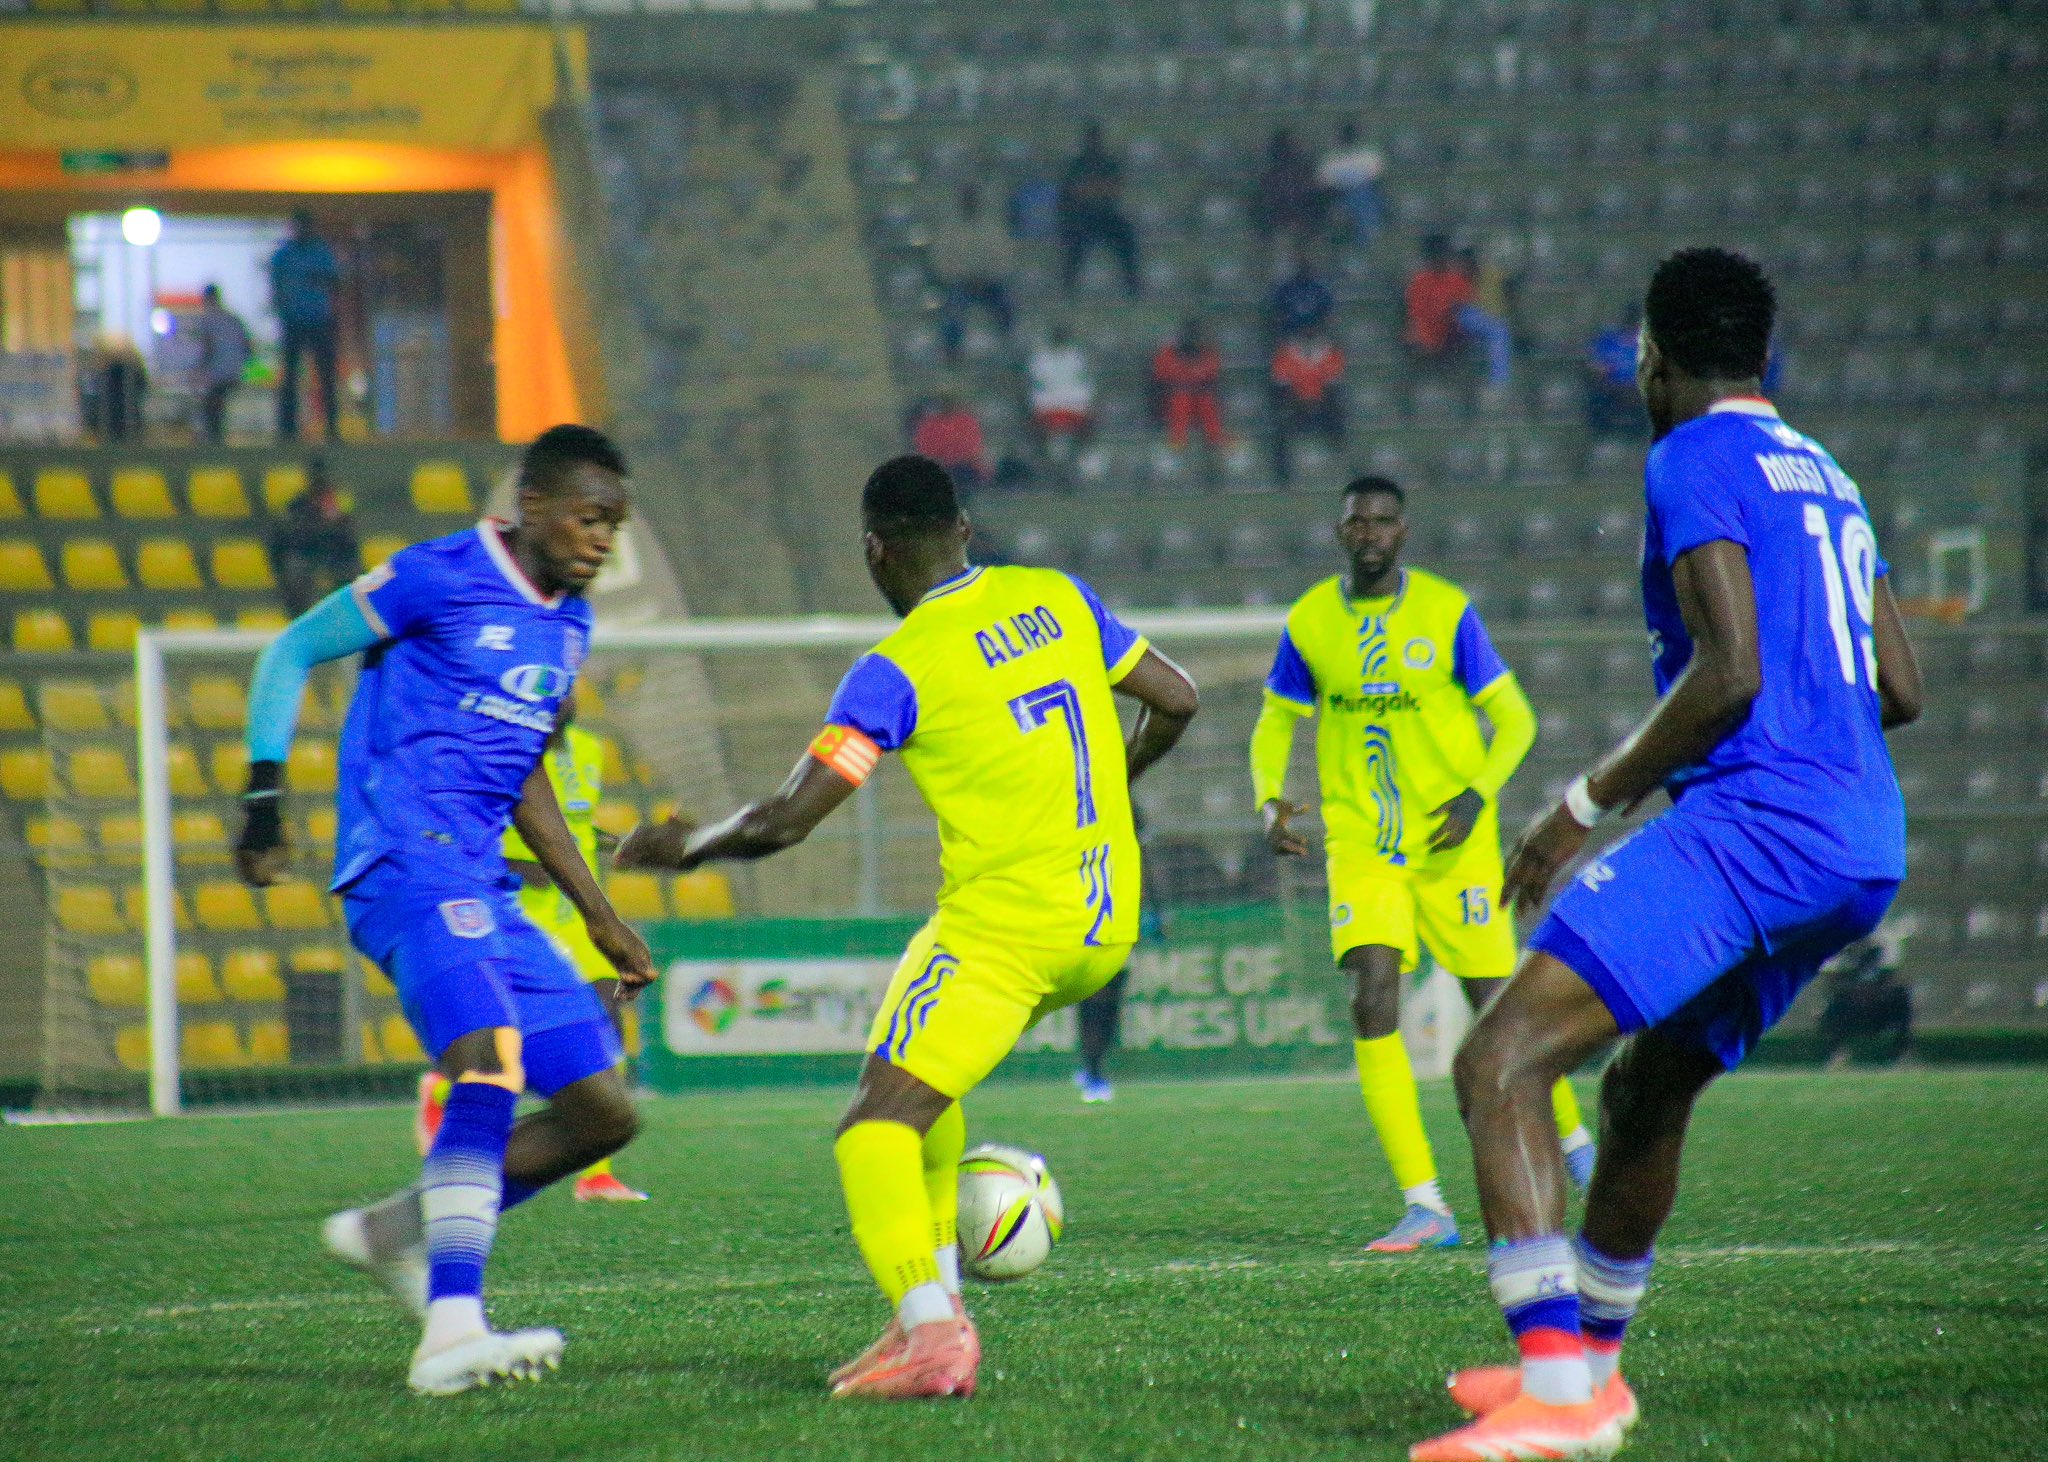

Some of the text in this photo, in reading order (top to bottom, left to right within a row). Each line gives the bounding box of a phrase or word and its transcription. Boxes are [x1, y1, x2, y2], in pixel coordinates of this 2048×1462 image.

[974, 605, 1064, 669] ALIRO
[1803, 503, 1879, 692] 19
[1007, 678, 1097, 829] 7
[1459, 887, 1489, 926] 15
